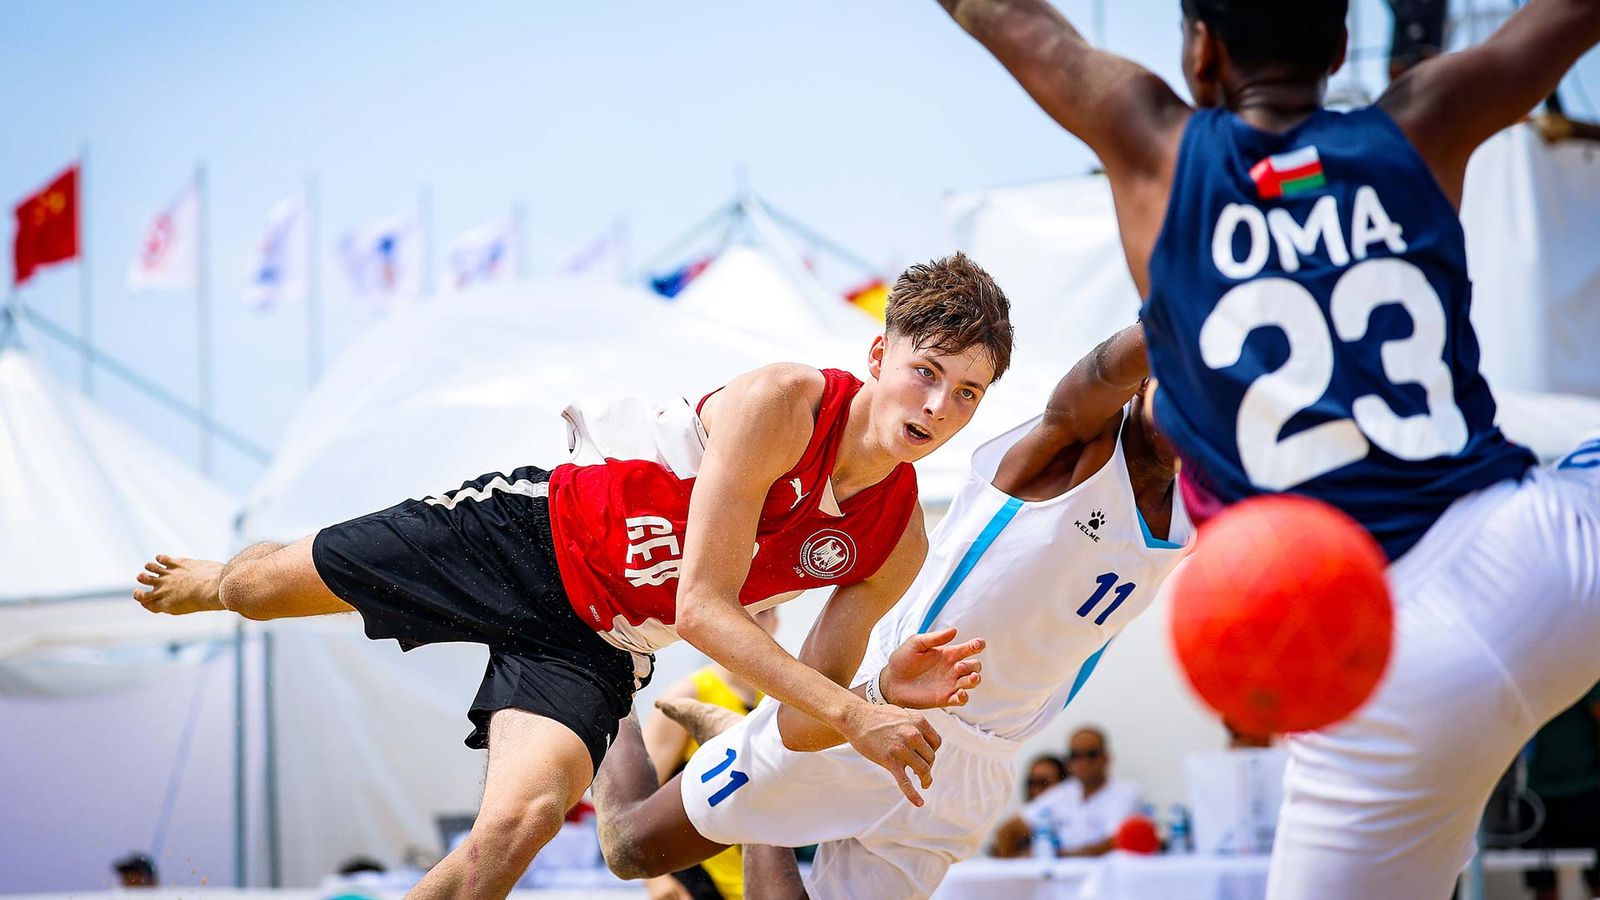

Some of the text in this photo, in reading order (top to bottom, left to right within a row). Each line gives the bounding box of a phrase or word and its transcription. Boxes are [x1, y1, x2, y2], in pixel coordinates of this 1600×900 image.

[1212, 185, 1407, 279] OMA
[1199, 257, 1469, 491] 23
[624, 515, 683, 587] GER
[1074, 520, 1101, 543] KELME
[1076, 572, 1136, 625] 11
[700, 747, 749, 807] 11
